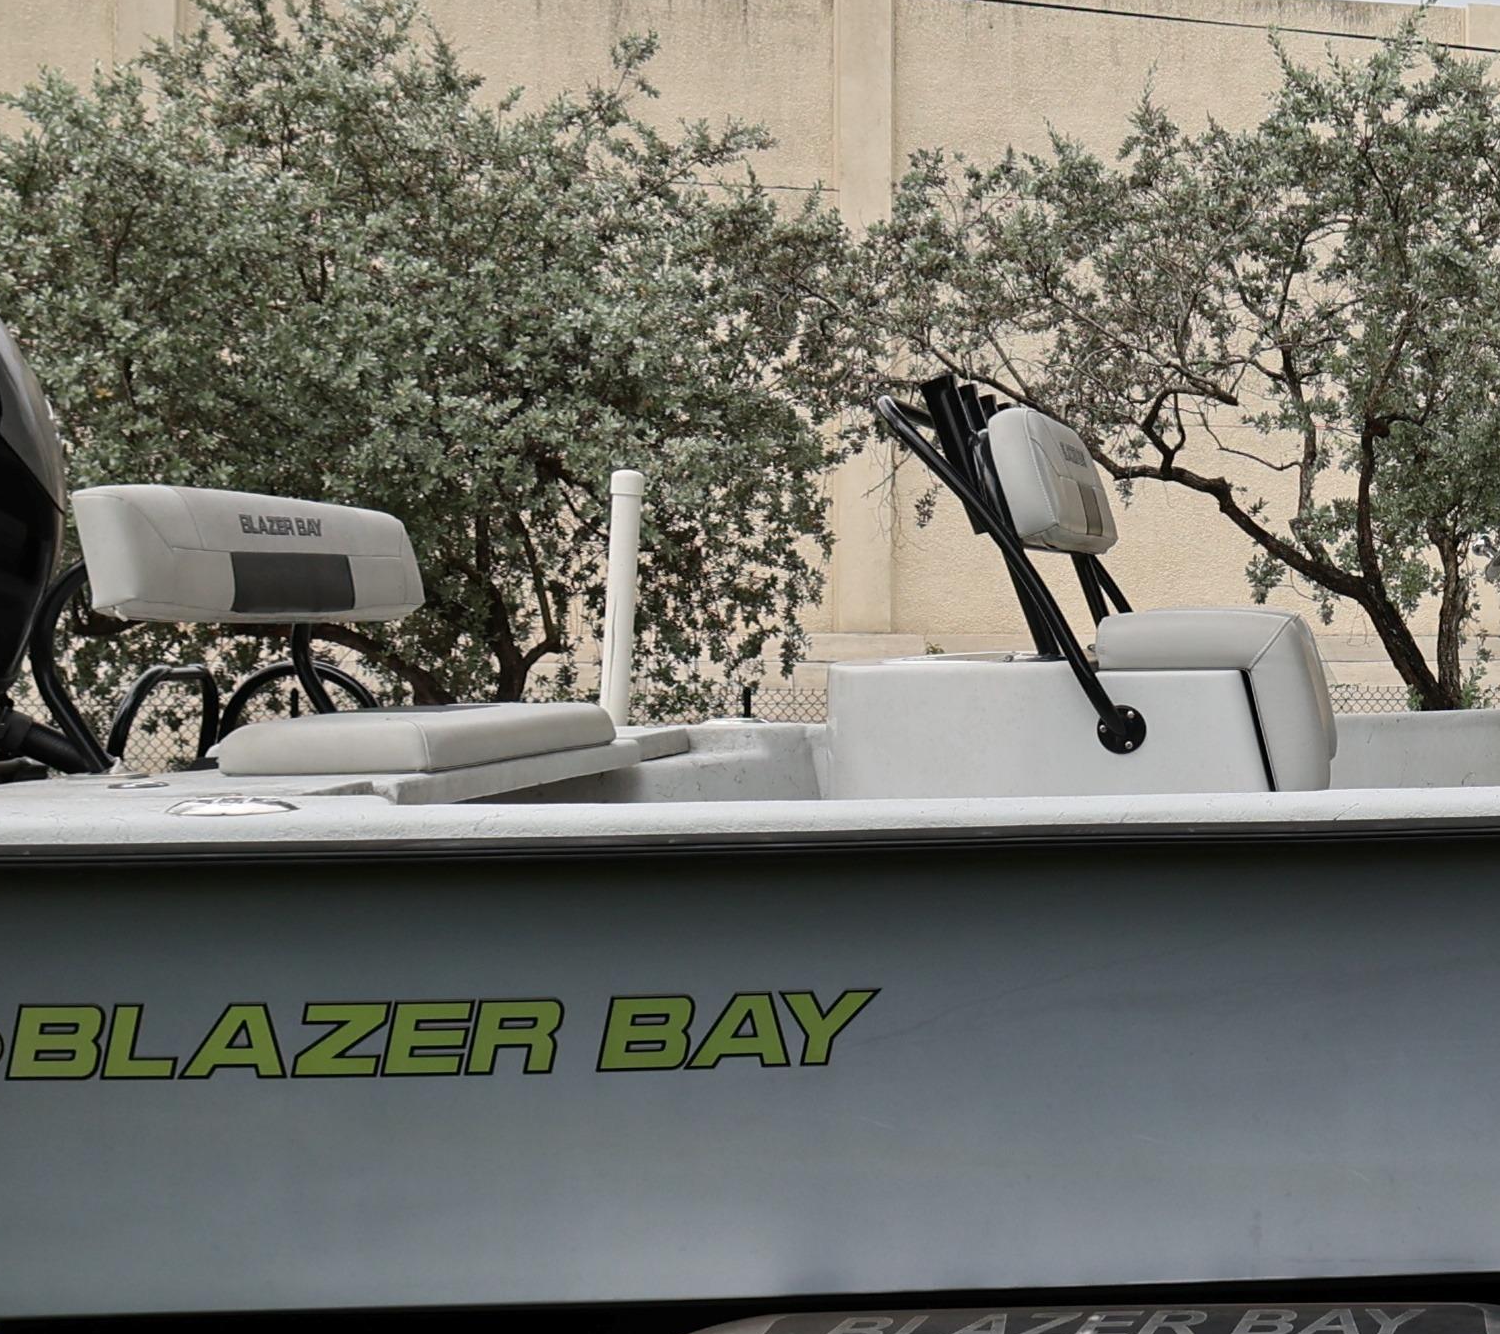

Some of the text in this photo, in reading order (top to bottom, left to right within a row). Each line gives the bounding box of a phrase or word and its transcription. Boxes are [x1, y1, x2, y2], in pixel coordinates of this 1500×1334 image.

[239, 513, 322, 537] BLAZER BAY
[4, 987, 882, 1080] BLAZER BAY
